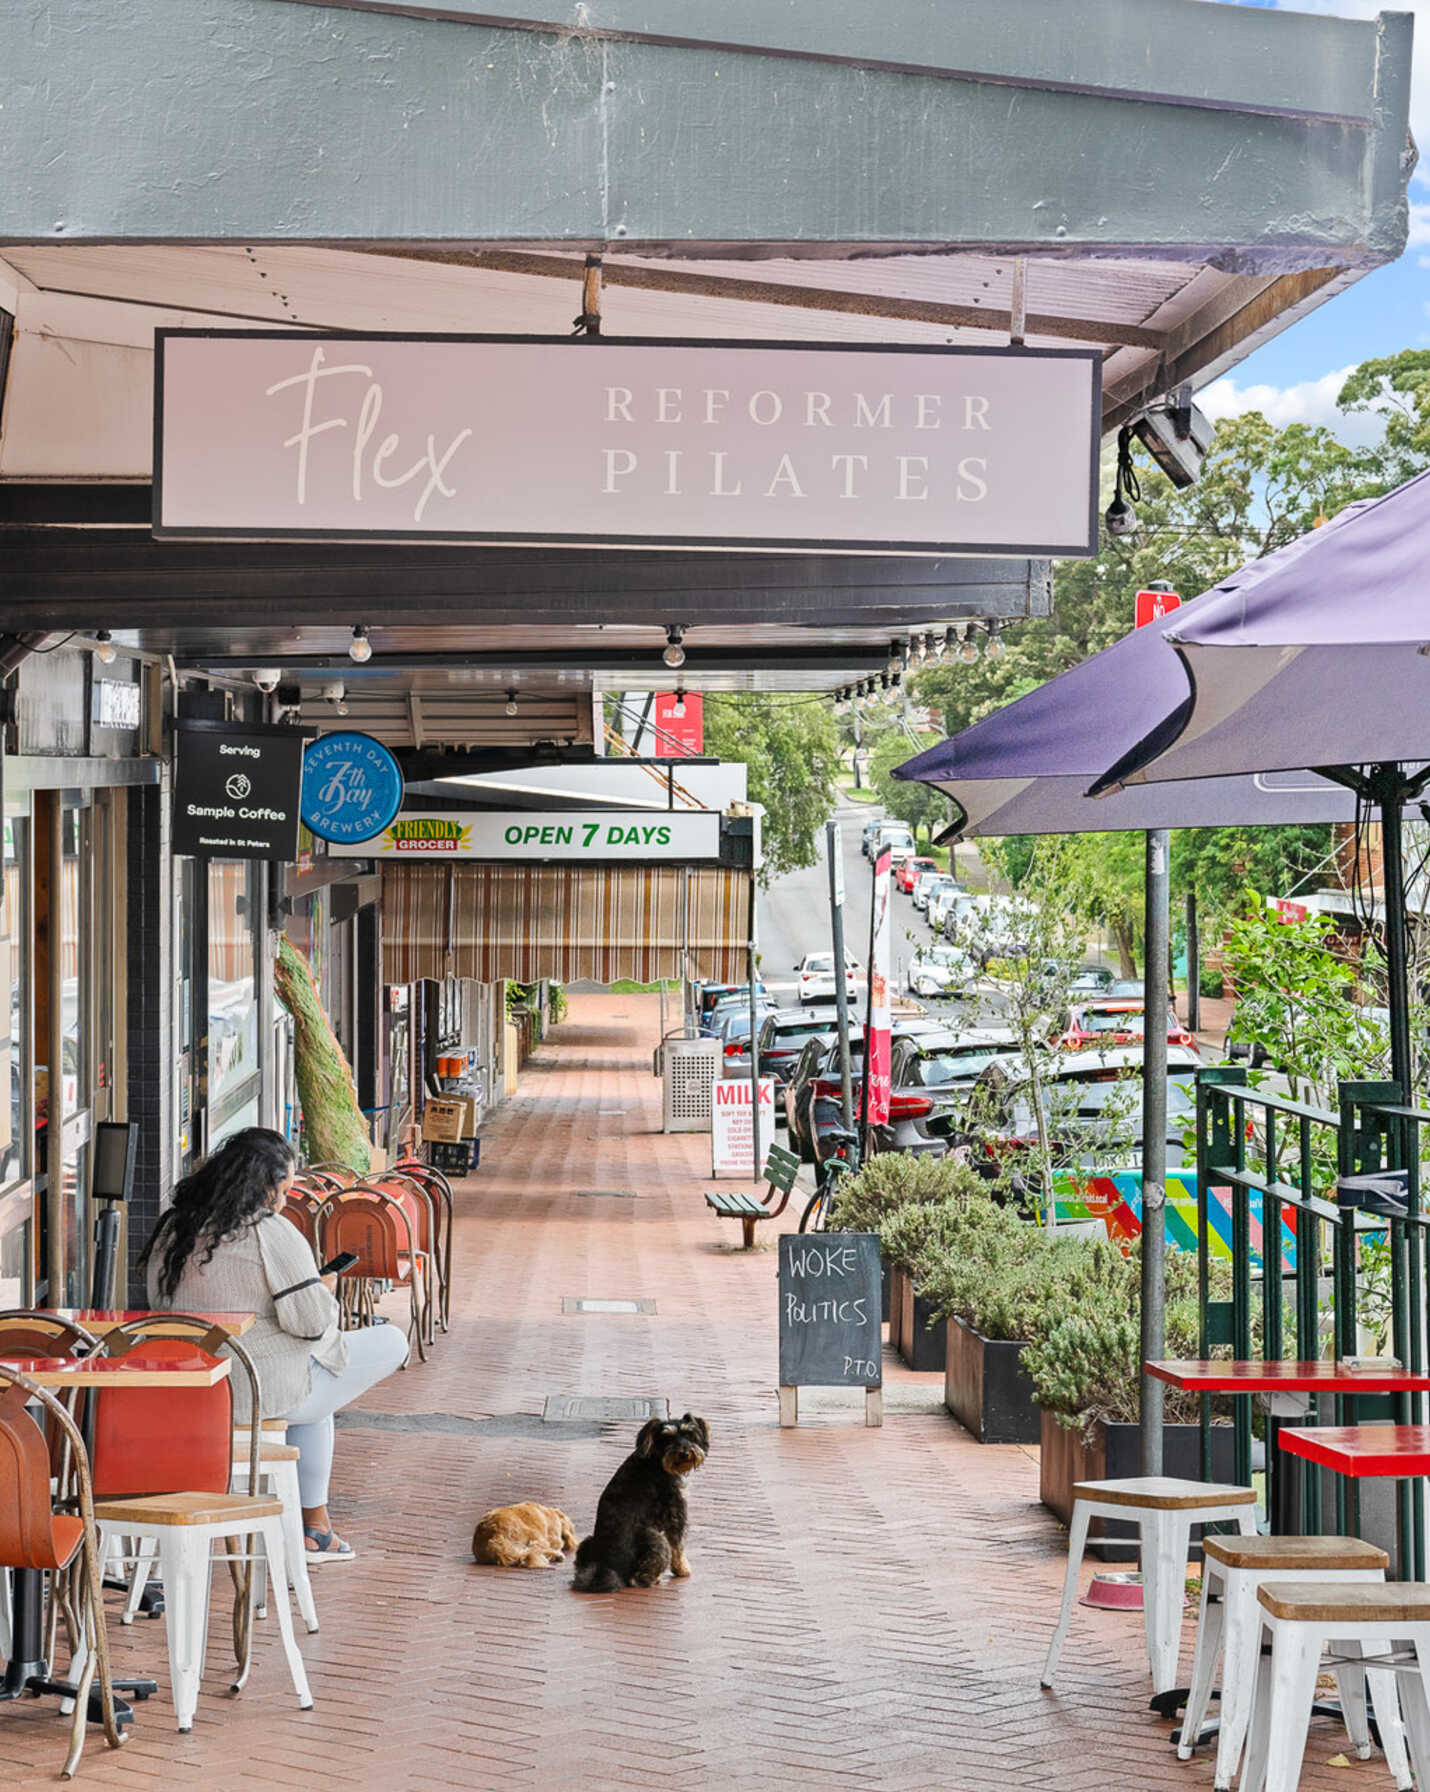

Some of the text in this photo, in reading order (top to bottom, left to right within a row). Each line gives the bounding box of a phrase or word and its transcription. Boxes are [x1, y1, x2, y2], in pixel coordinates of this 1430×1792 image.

[604, 386, 993, 431] REFORMER
[266, 345, 472, 522] Flex
[602, 449, 988, 502] PILATES
[219, 744, 261, 759] Serving
[305, 742, 389, 774] SEVENTH DAY
[318, 781, 374, 815] Day
[187, 804, 286, 821] Sample Coffee
[310, 811, 382, 833] BREWERY
[396, 820, 460, 839] FRIENDLY
[504, 824, 671, 847] OPEN 7 DAYS
[200, 837, 228, 846] Roasted
[247, 840, 270, 848] Peters
[398, 840, 456, 850] GROCER
[716, 1084, 772, 1105] MILK
[788, 1245, 857, 1278] WOKE
